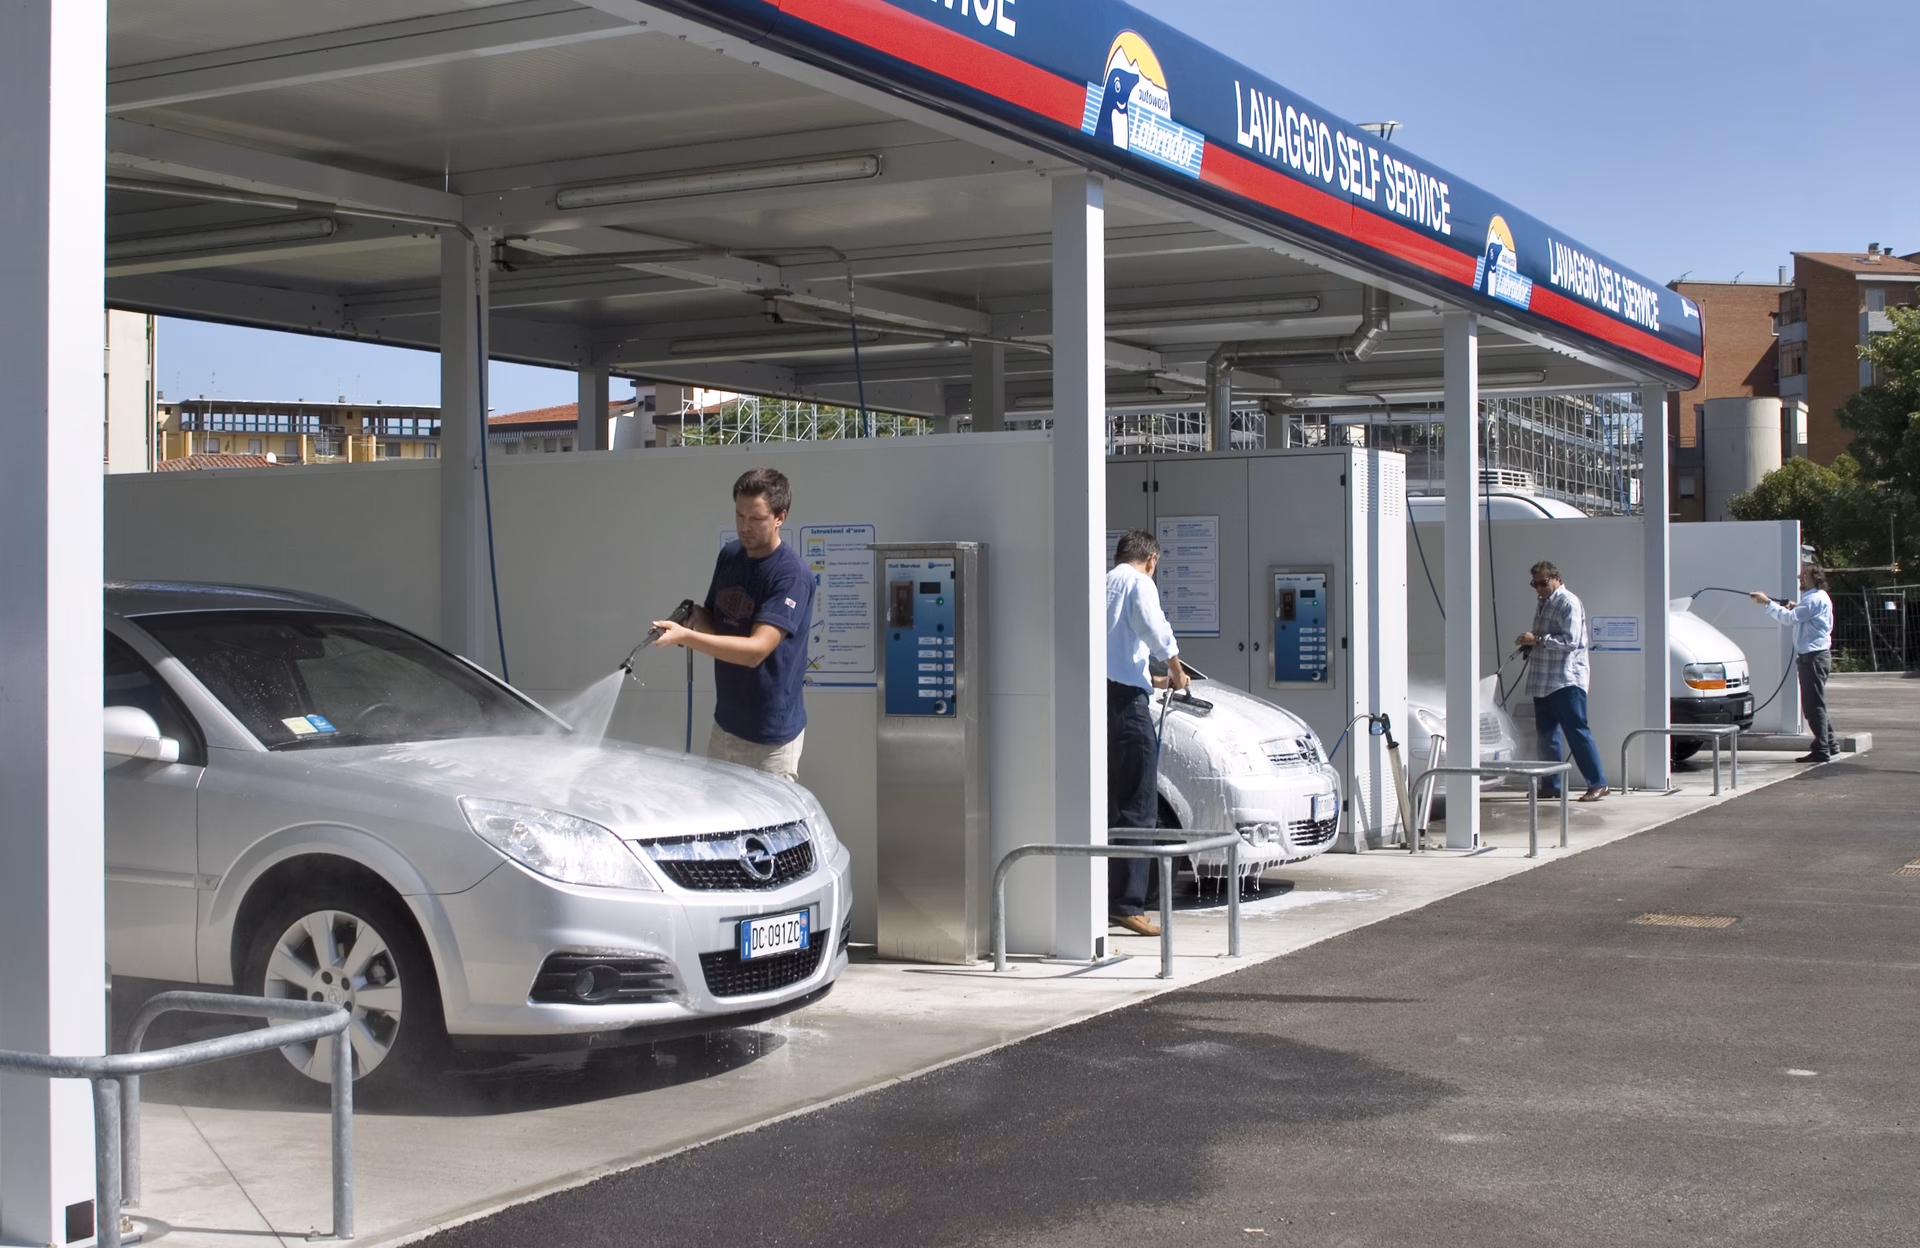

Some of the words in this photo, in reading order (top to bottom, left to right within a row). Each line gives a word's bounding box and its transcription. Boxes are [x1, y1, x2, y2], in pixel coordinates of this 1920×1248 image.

[1130, 106, 1197, 167] Labrador
[1138, 88, 1169, 113] autowash
[1235, 80, 1334, 184] LAVAGGIO
[1336, 130, 1381, 202] SELF
[1383, 153, 1452, 236] SERVICE
[1548, 238, 1599, 303] LAVAGGIO
[1598, 263, 1622, 313] SELF
[1622, 276, 1660, 332] SERVICE
